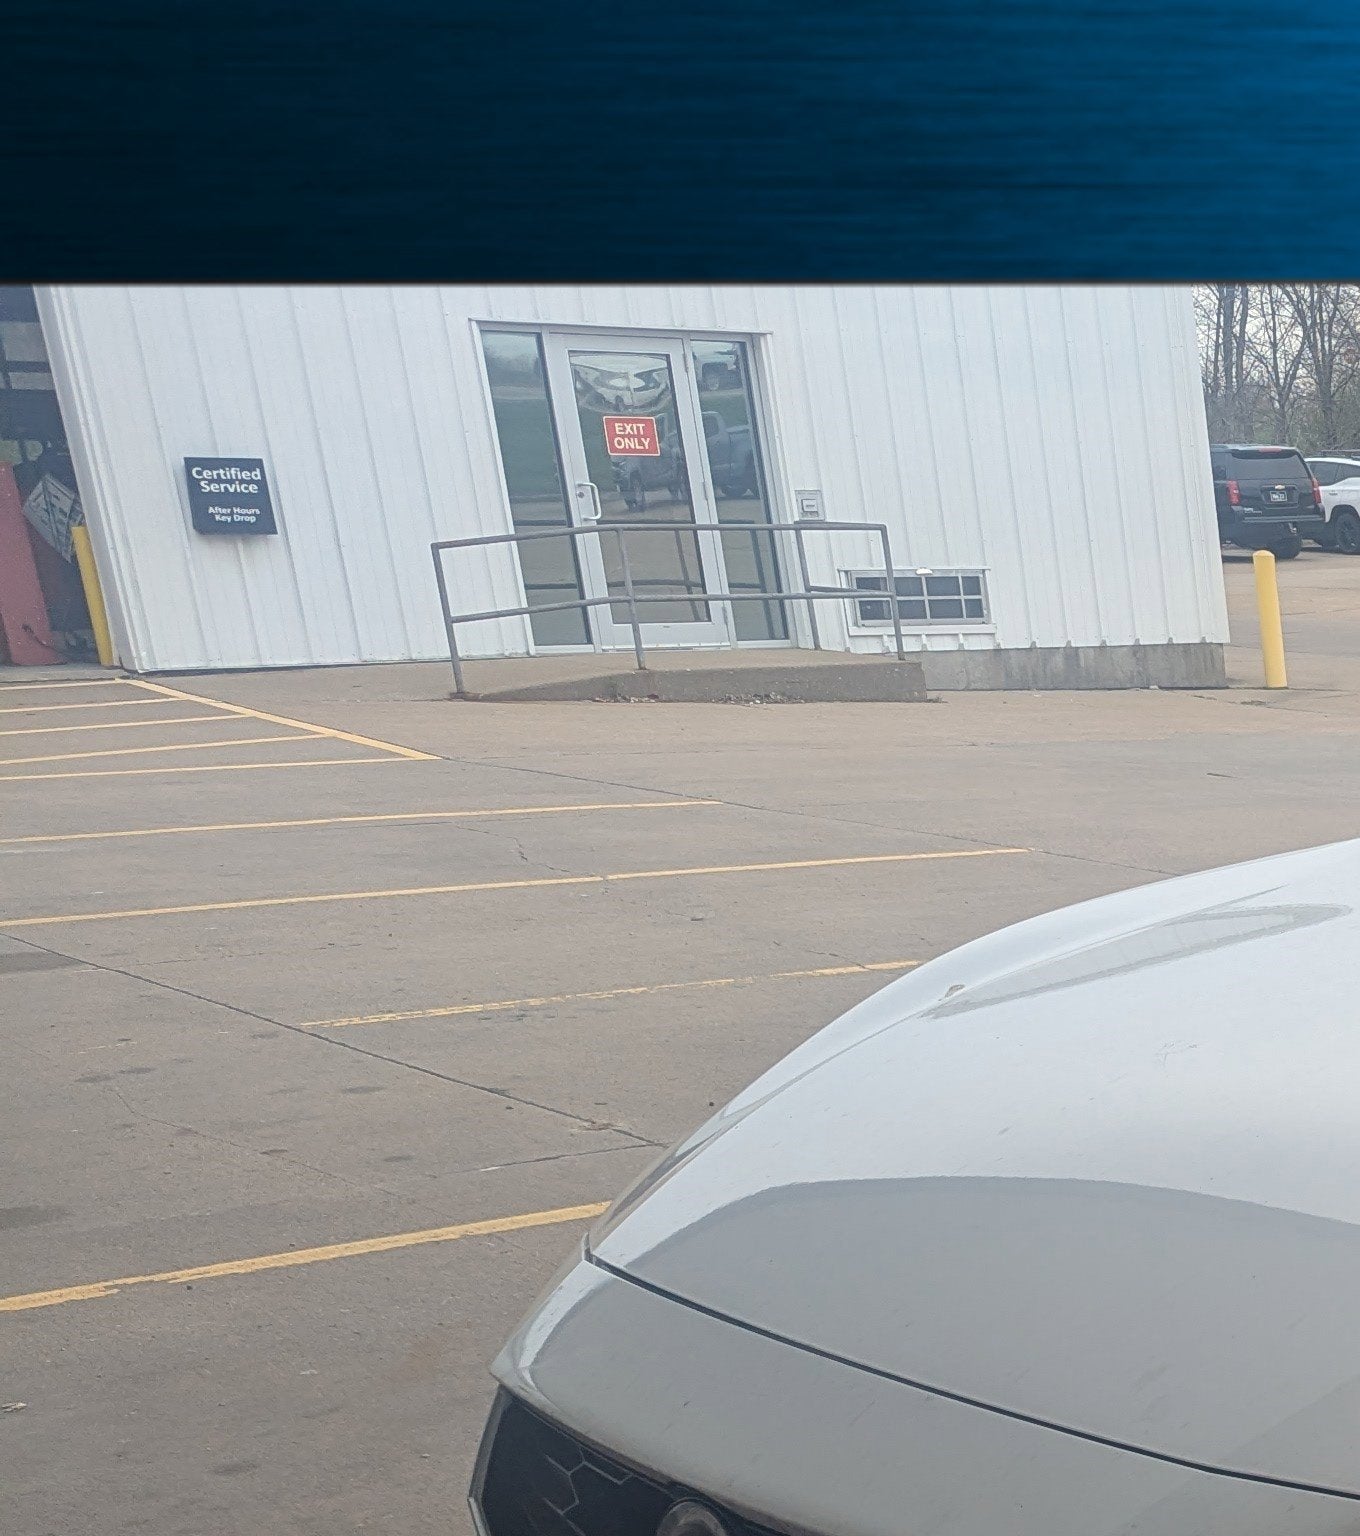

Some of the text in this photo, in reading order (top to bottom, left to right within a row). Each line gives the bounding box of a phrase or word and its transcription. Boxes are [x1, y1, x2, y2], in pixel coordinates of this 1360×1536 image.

[614, 423, 645, 435] EXIT
[613, 437, 650, 449] ONLY
[191, 466, 262, 480] Certified
[200, 480, 259, 493] Service
[208, 506, 261, 514] After Hours
[215, 514, 257, 523] Key Drop
